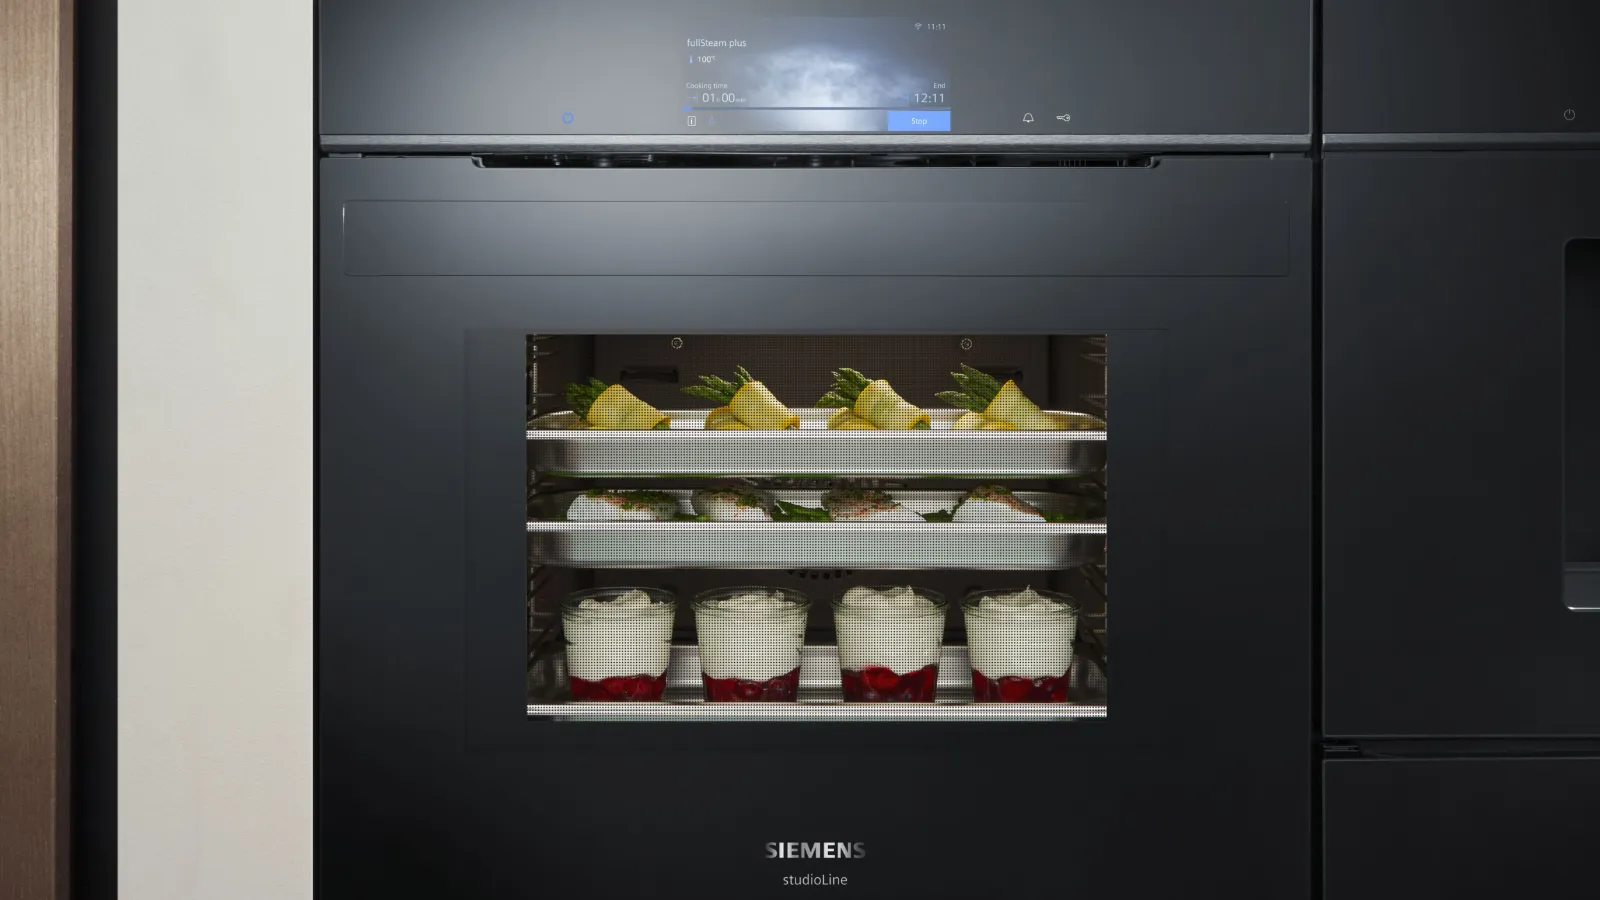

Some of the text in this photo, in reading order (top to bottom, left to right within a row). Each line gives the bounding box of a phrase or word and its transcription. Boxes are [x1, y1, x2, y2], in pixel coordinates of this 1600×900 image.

[687, 38, 747, 49] fullSteam plus
[686, 82, 712, 90] Cooking
[914, 93, 944, 103] 12:11
[911, 117, 928, 126] Stop
[765, 842, 866, 859] SIEMENS
[783, 873, 848, 886] studioLine
